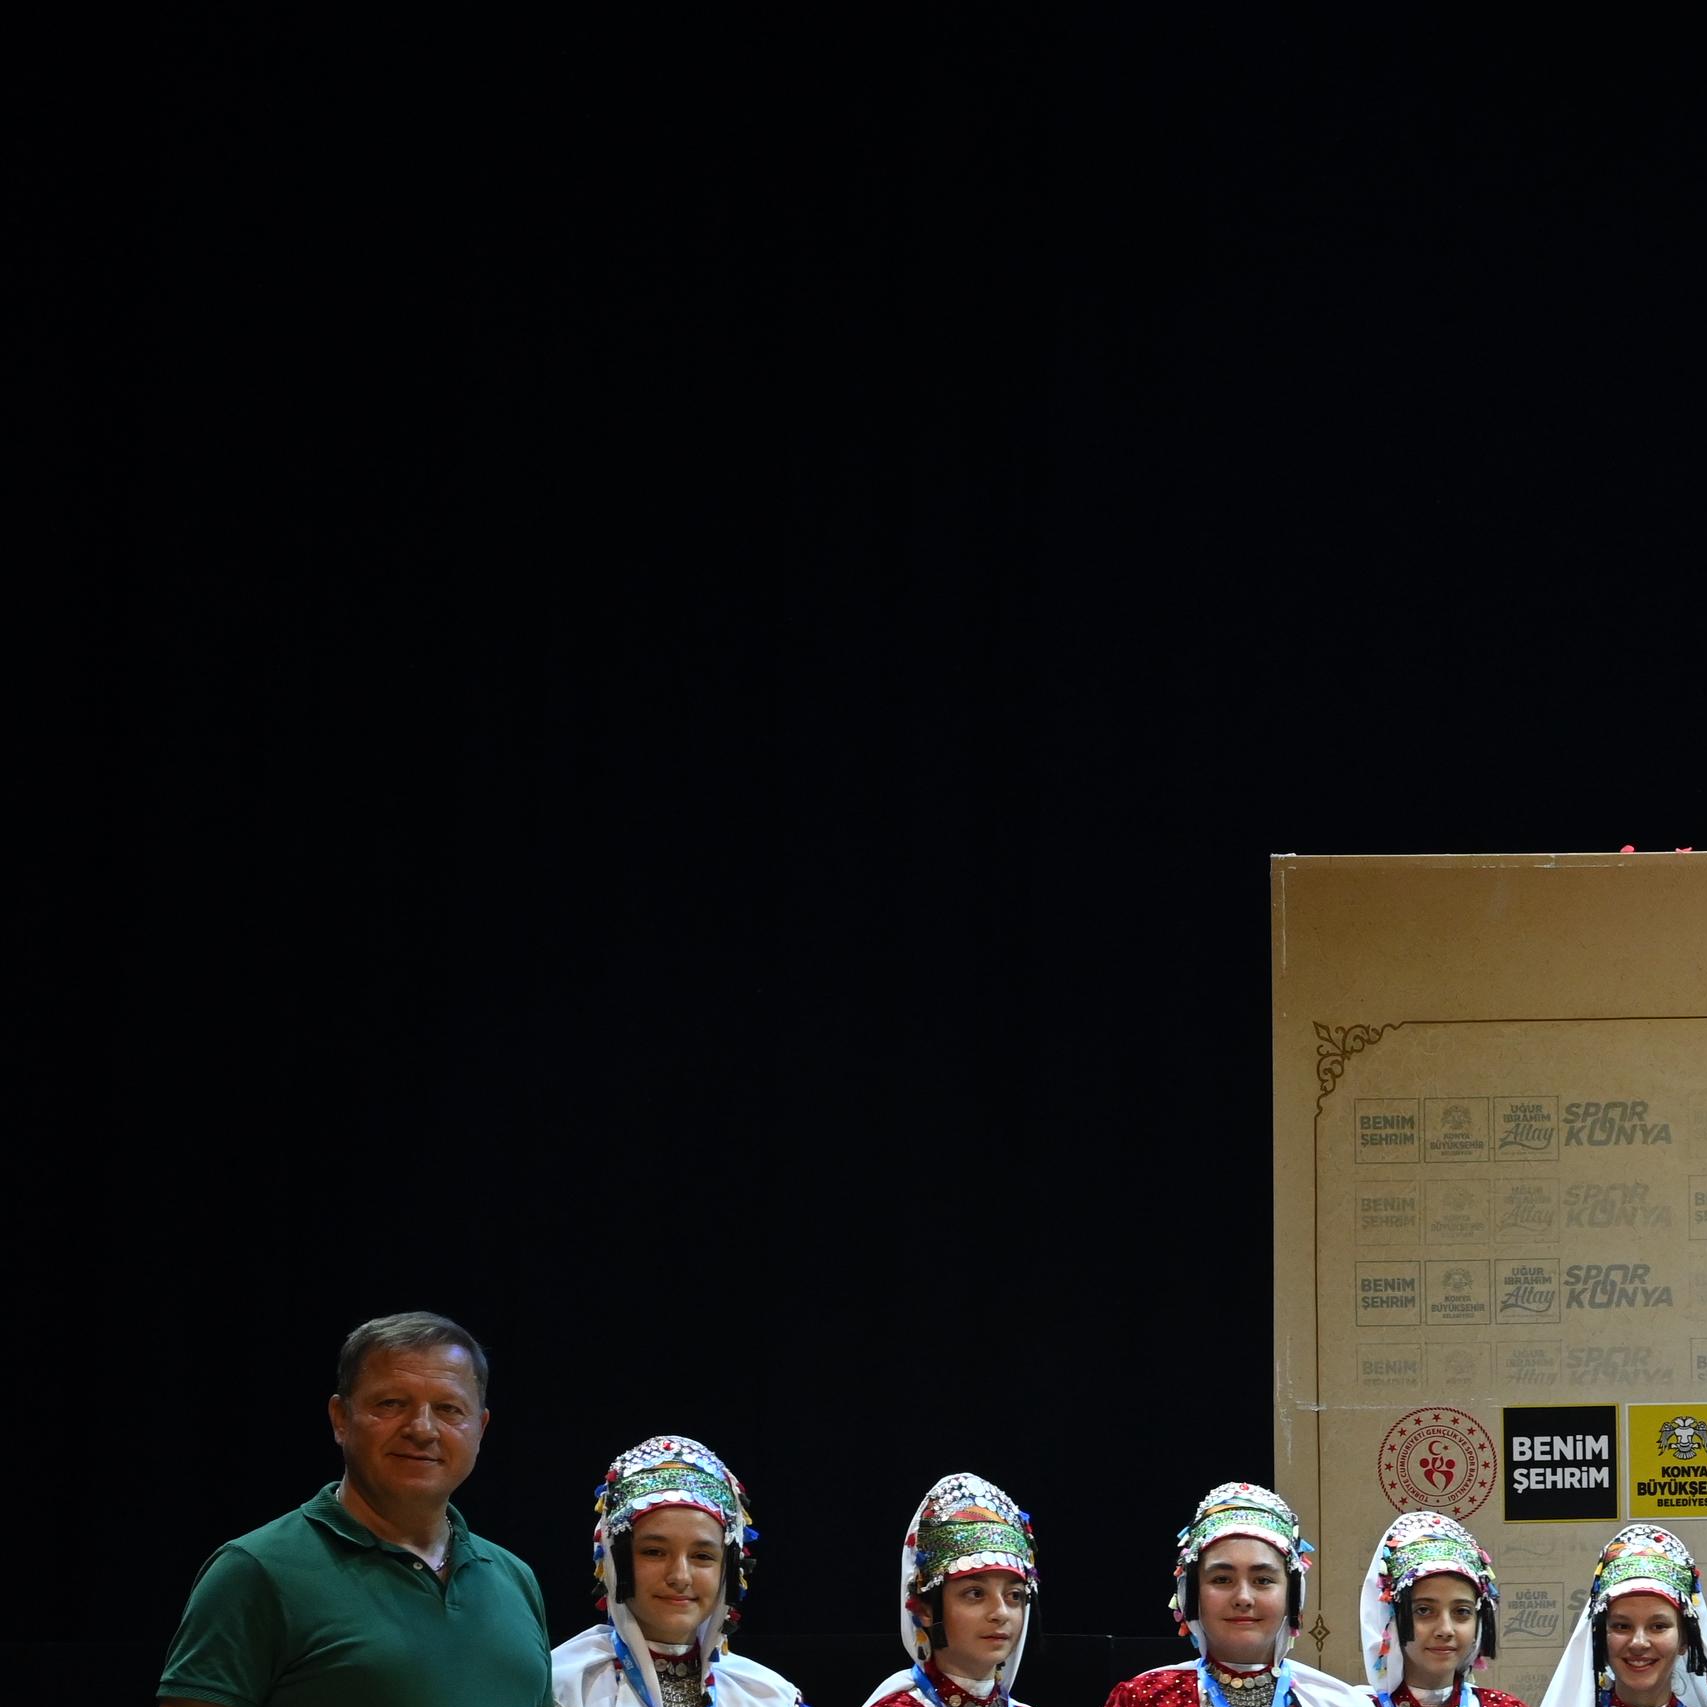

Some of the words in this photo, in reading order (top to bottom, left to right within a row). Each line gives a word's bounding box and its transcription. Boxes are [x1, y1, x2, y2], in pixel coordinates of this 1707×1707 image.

[1510, 1103, 1543, 1114] UĞUR
[1562, 1101, 1649, 1130] SPOR
[1500, 1123, 1555, 1151] Altay
[1564, 1117, 1673, 1147] KONYA
[1562, 1182, 1650, 1212] SPOR
[1565, 1198, 1673, 1228] KONYA
[1511, 1266, 1544, 1277] UĞUR
[1563, 1264, 1651, 1293] SPOR
[1500, 1286, 1556, 1313] Altay
[1566, 1280, 1674, 1309] KONYA
[1566, 1346, 1652, 1372] SPOR
[1456, 1436, 1468, 1447] VE
[1463, 1445, 1475, 1466] SPOR
[1515, 1589, 1548, 1600] UĞUR
[1503, 1609, 1559, 1637] Altay
